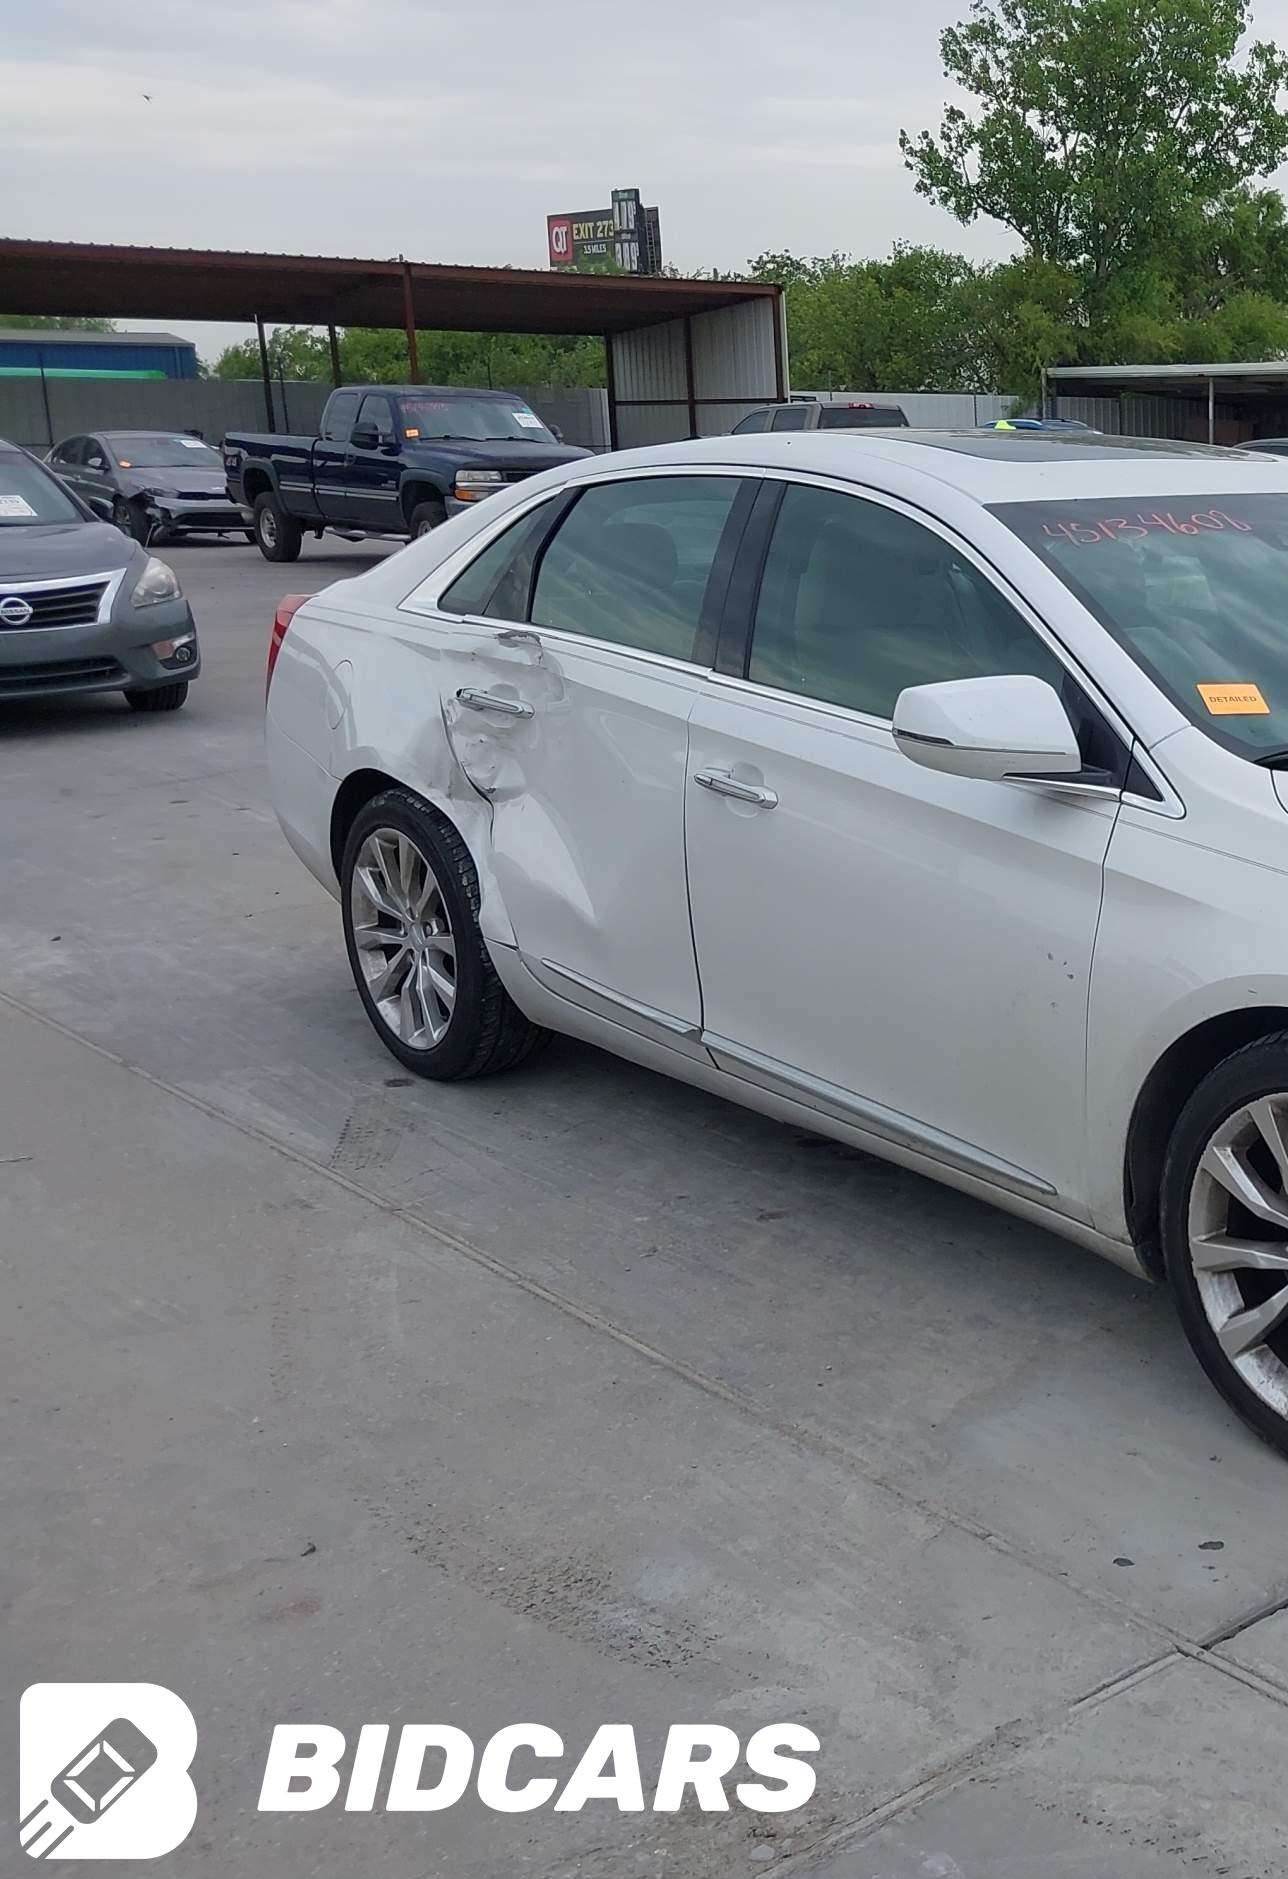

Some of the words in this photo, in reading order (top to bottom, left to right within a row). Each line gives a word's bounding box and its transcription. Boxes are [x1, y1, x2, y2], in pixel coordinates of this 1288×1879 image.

[553, 226, 568, 254] QT
[573, 223, 594, 240] EXIT
[597, 220, 614, 238] 273
[592, 244, 606, 253] MILES
